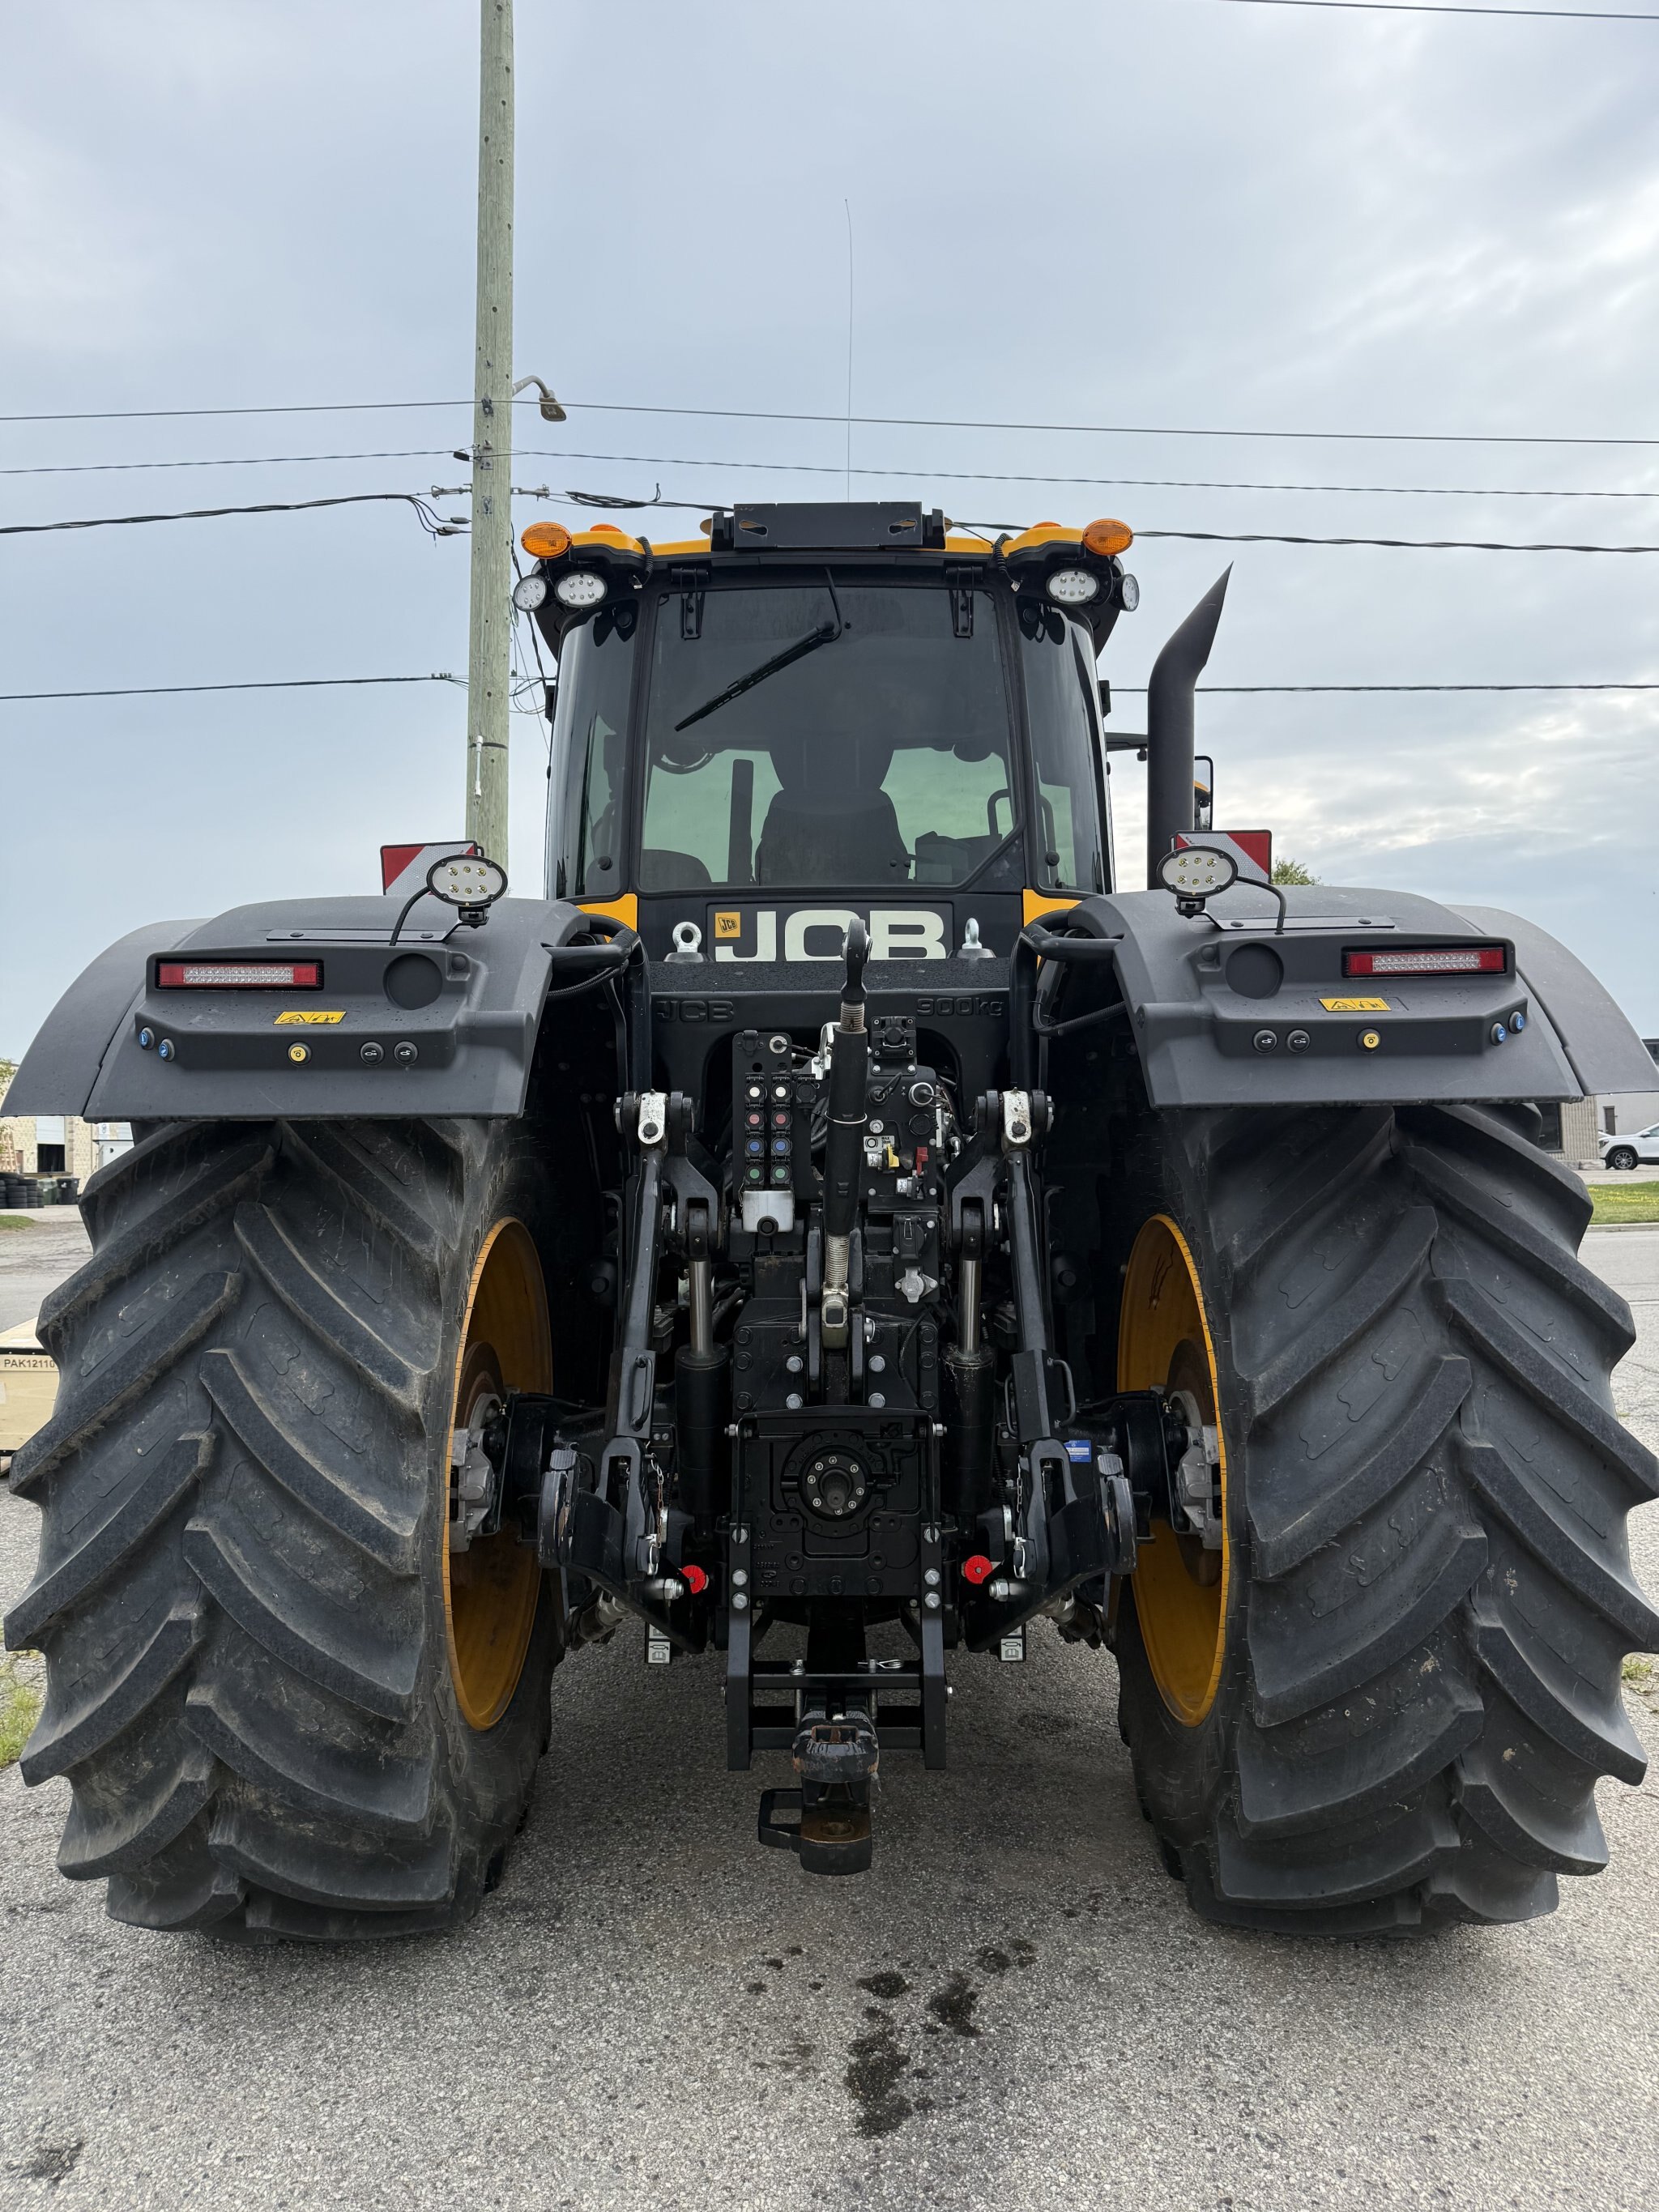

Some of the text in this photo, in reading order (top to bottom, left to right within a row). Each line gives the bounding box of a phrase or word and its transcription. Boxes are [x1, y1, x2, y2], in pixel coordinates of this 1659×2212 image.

[715, 910, 947, 961] JCB
[721, 918, 736, 931] JCB
[656, 999, 735, 1023] JCB
[916, 998, 1004, 1018] 900kg
